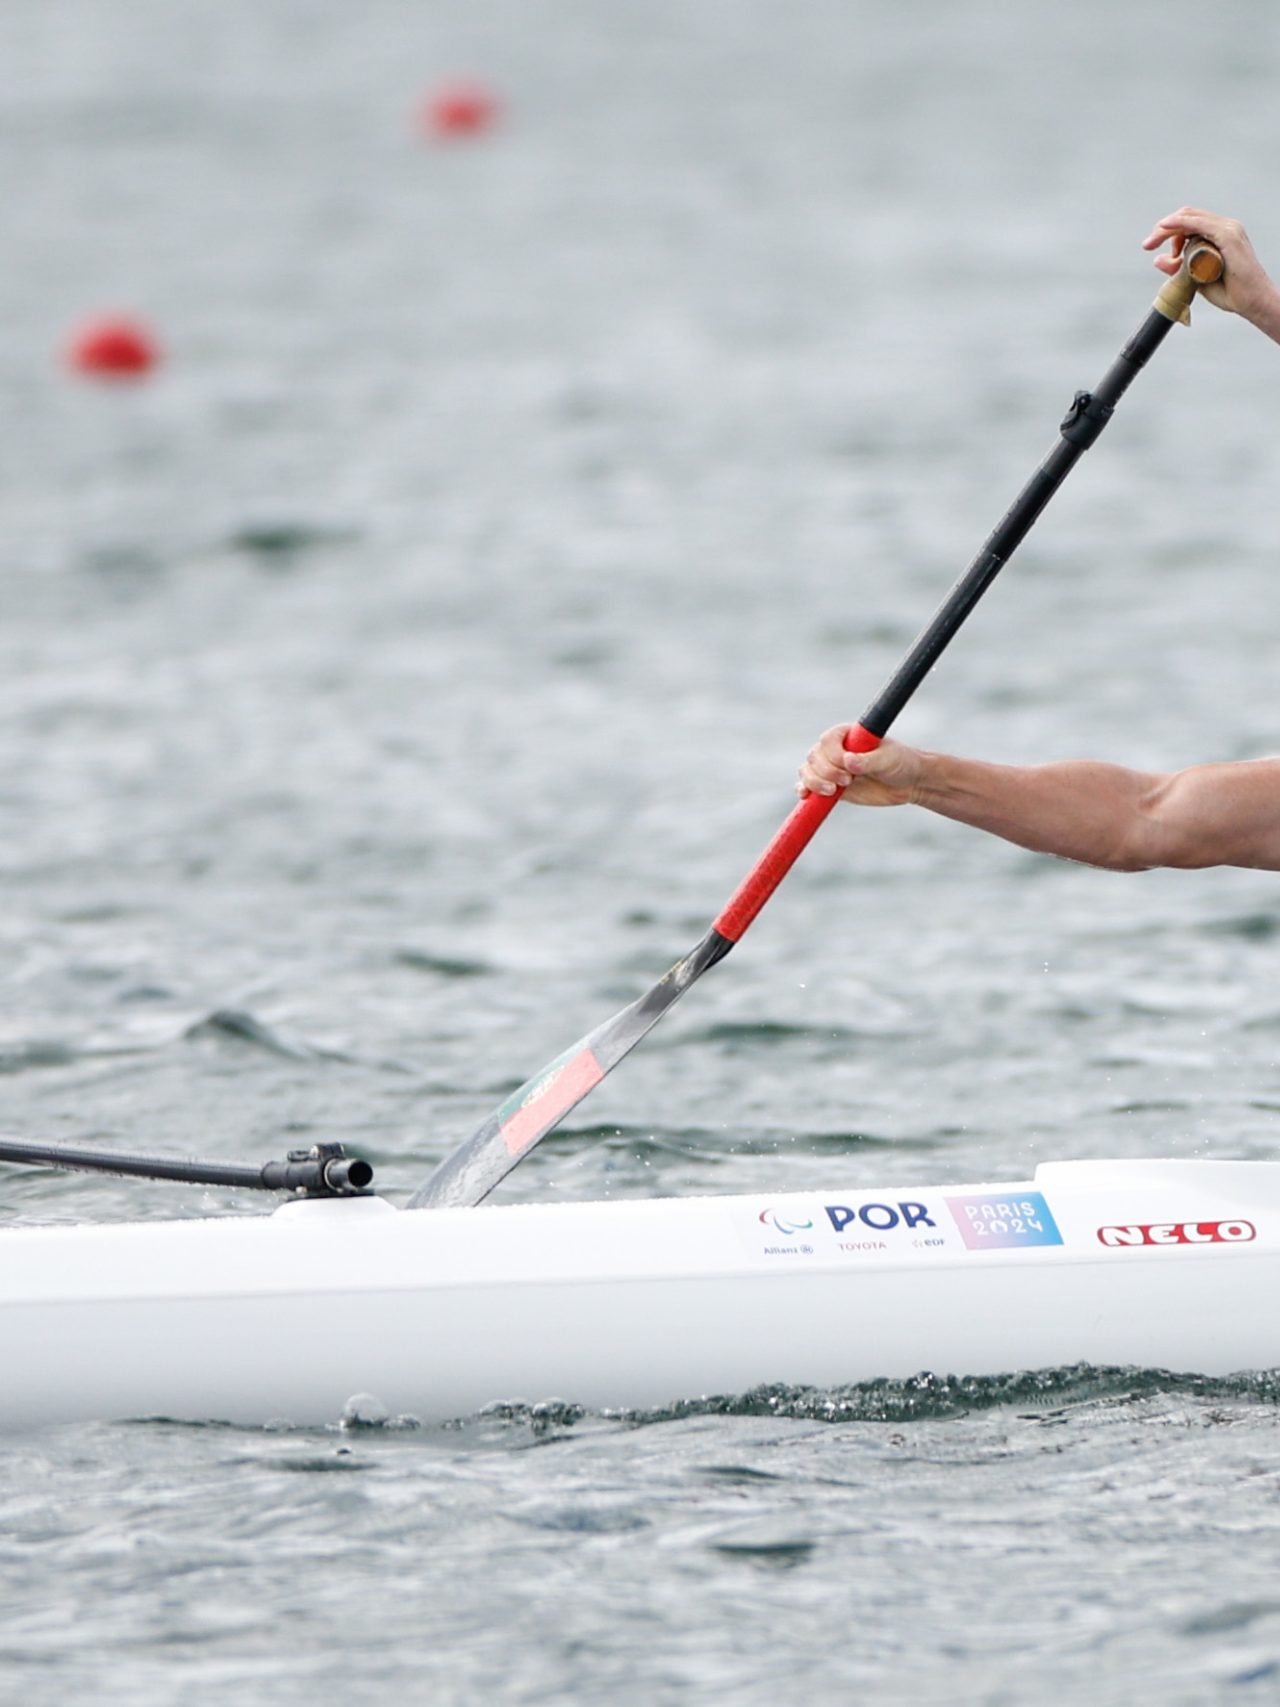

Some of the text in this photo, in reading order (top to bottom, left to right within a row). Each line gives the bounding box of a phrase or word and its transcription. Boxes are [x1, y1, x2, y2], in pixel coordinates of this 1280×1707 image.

[824, 1201, 937, 1233] POR
[964, 1201, 1036, 1221] PARIS
[972, 1217, 1044, 1236] 2024
[1101, 1221, 1254, 1246] NELO
[838, 1241, 888, 1251] TOYOTA
